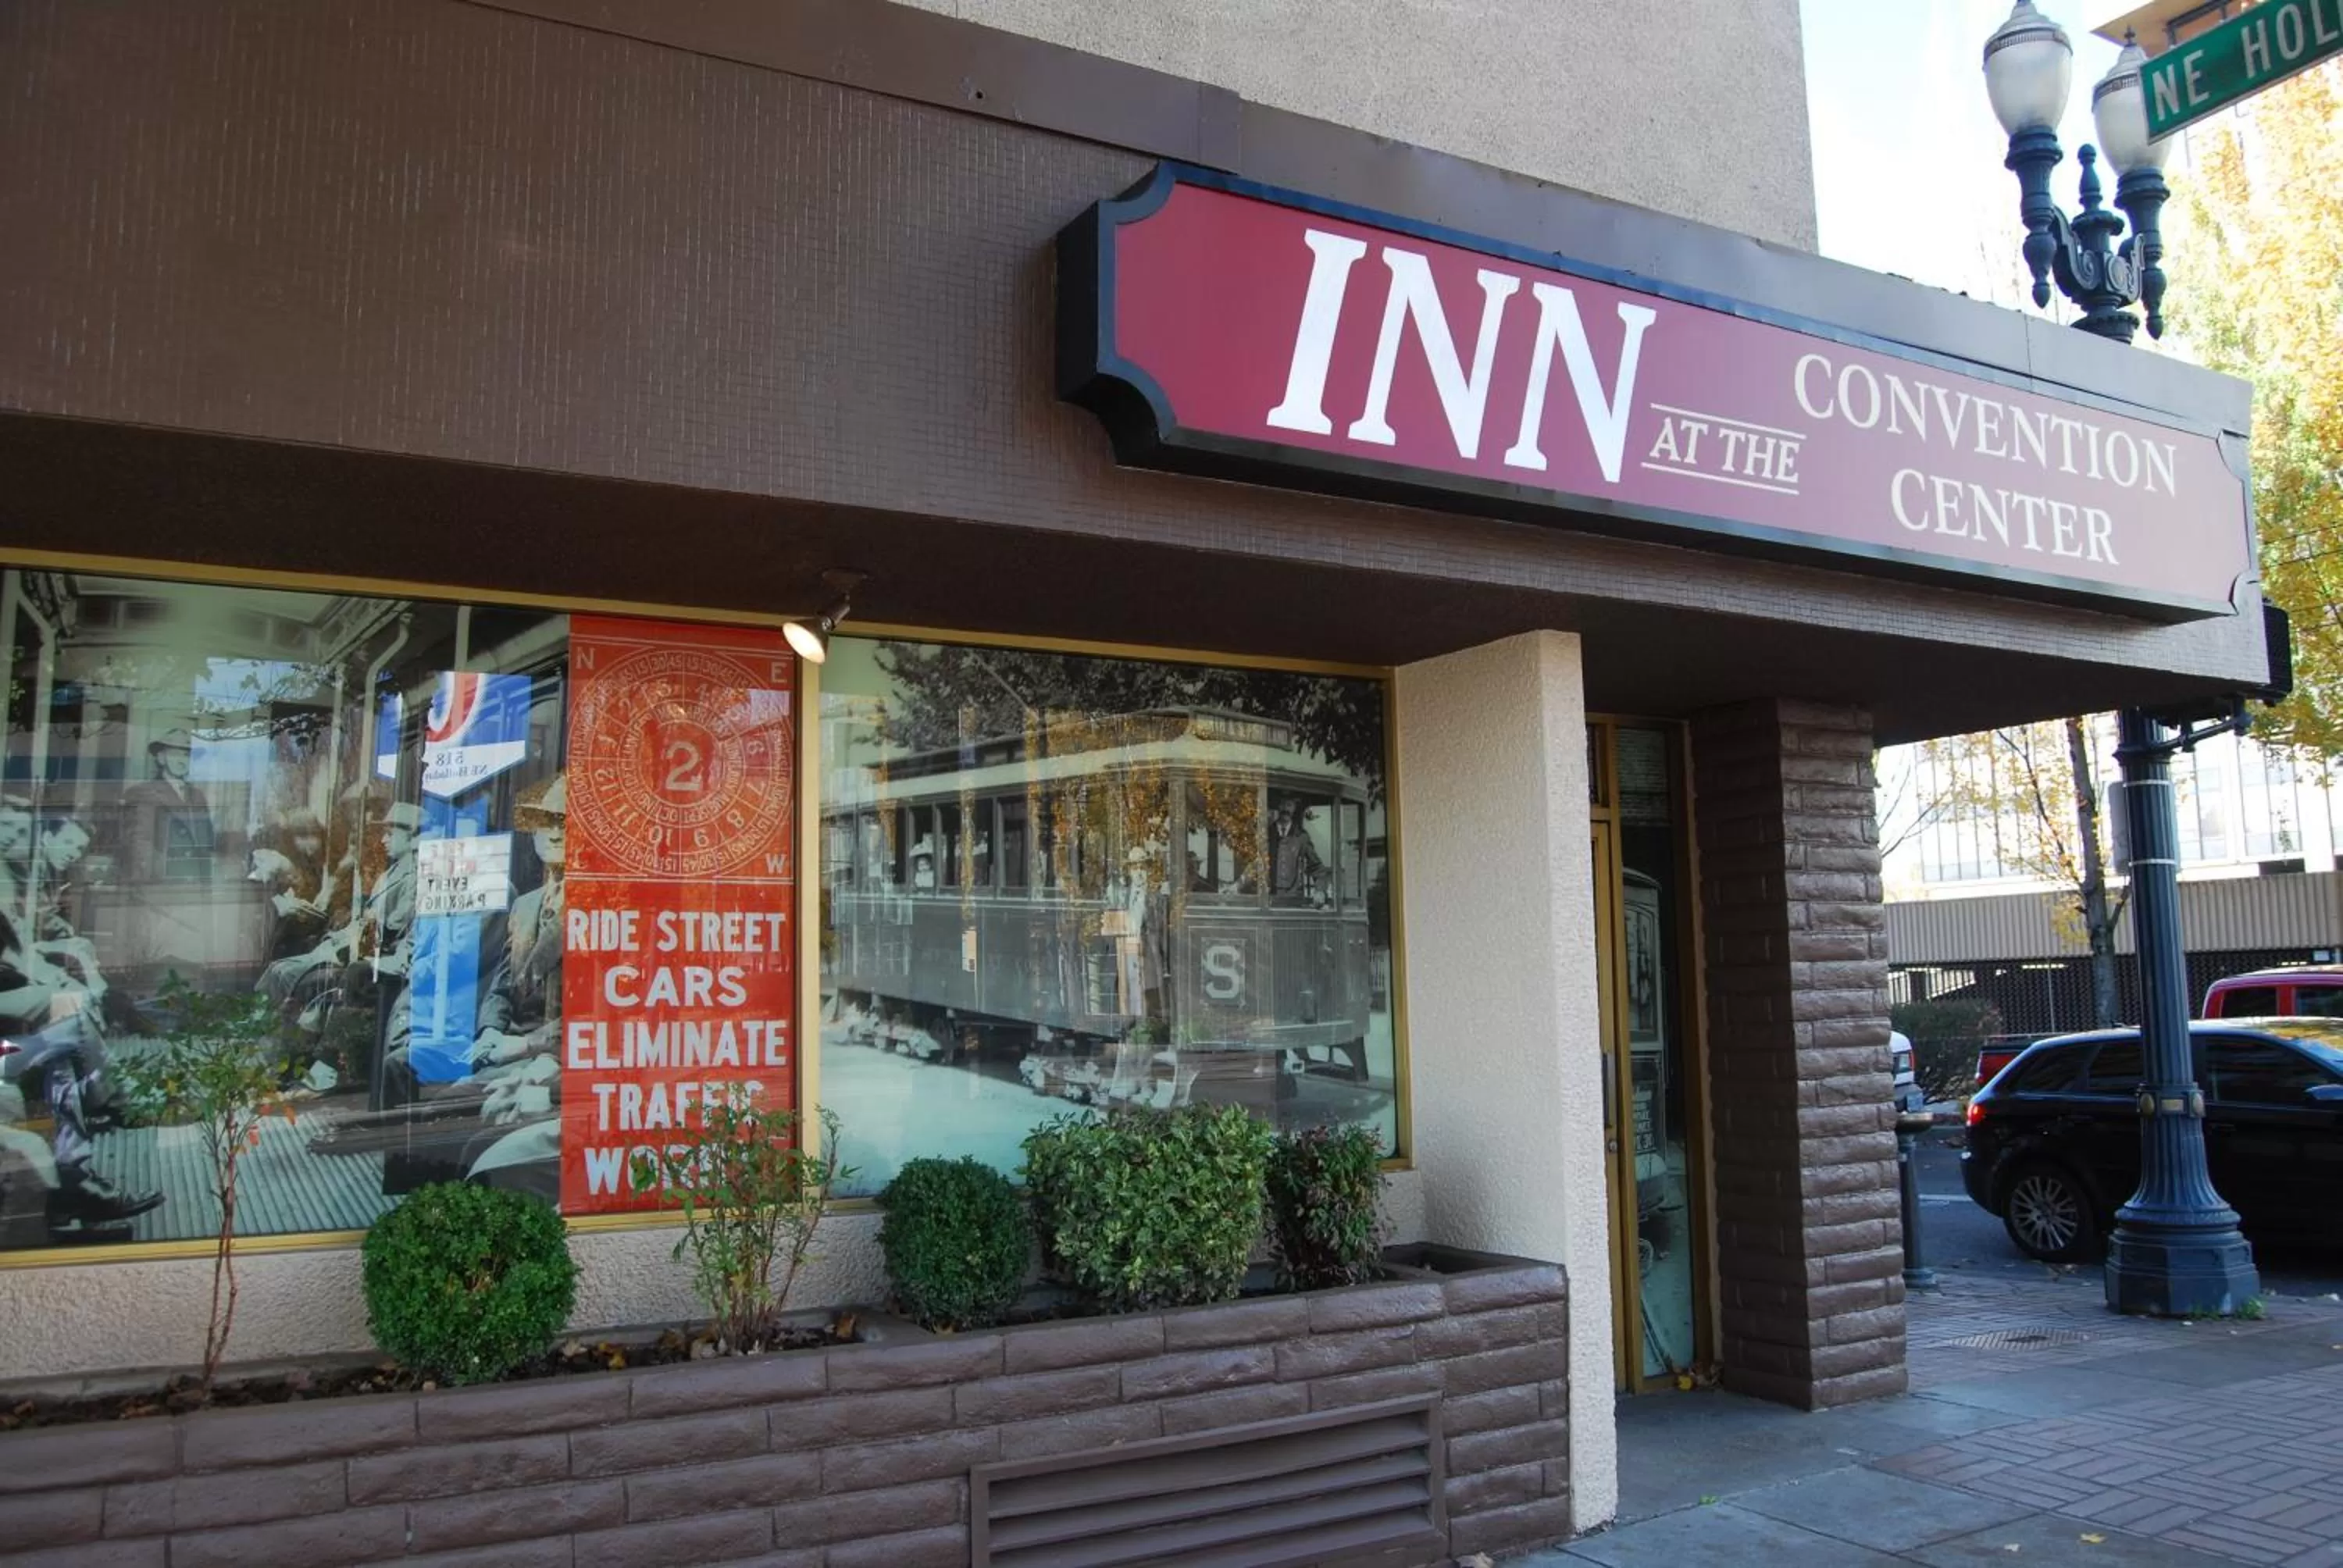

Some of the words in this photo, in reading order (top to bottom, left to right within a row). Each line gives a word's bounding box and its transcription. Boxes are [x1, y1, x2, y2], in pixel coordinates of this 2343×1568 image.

[2151, 49, 2212, 122] NE
[2241, 0, 2343, 79] HOL
[1267, 228, 1657, 483] INN
[1649, 416, 1709, 465] AT
[1719, 428, 1800, 483] THE
[1795, 354, 2177, 498] CONVENTION
[1891, 469, 2120, 565] CENTER
[575, 646, 596, 670] N
[771, 662, 788, 683] E
[665, 740, 701, 791] 2
[765, 853, 788, 875] W
[567, 908, 640, 952] RIDE
[656, 911, 786, 953] STREET
[604, 966, 747, 1007] CARS
[1205, 946, 1240, 999] S
[567, 1020, 786, 1069] ELIMINATE
